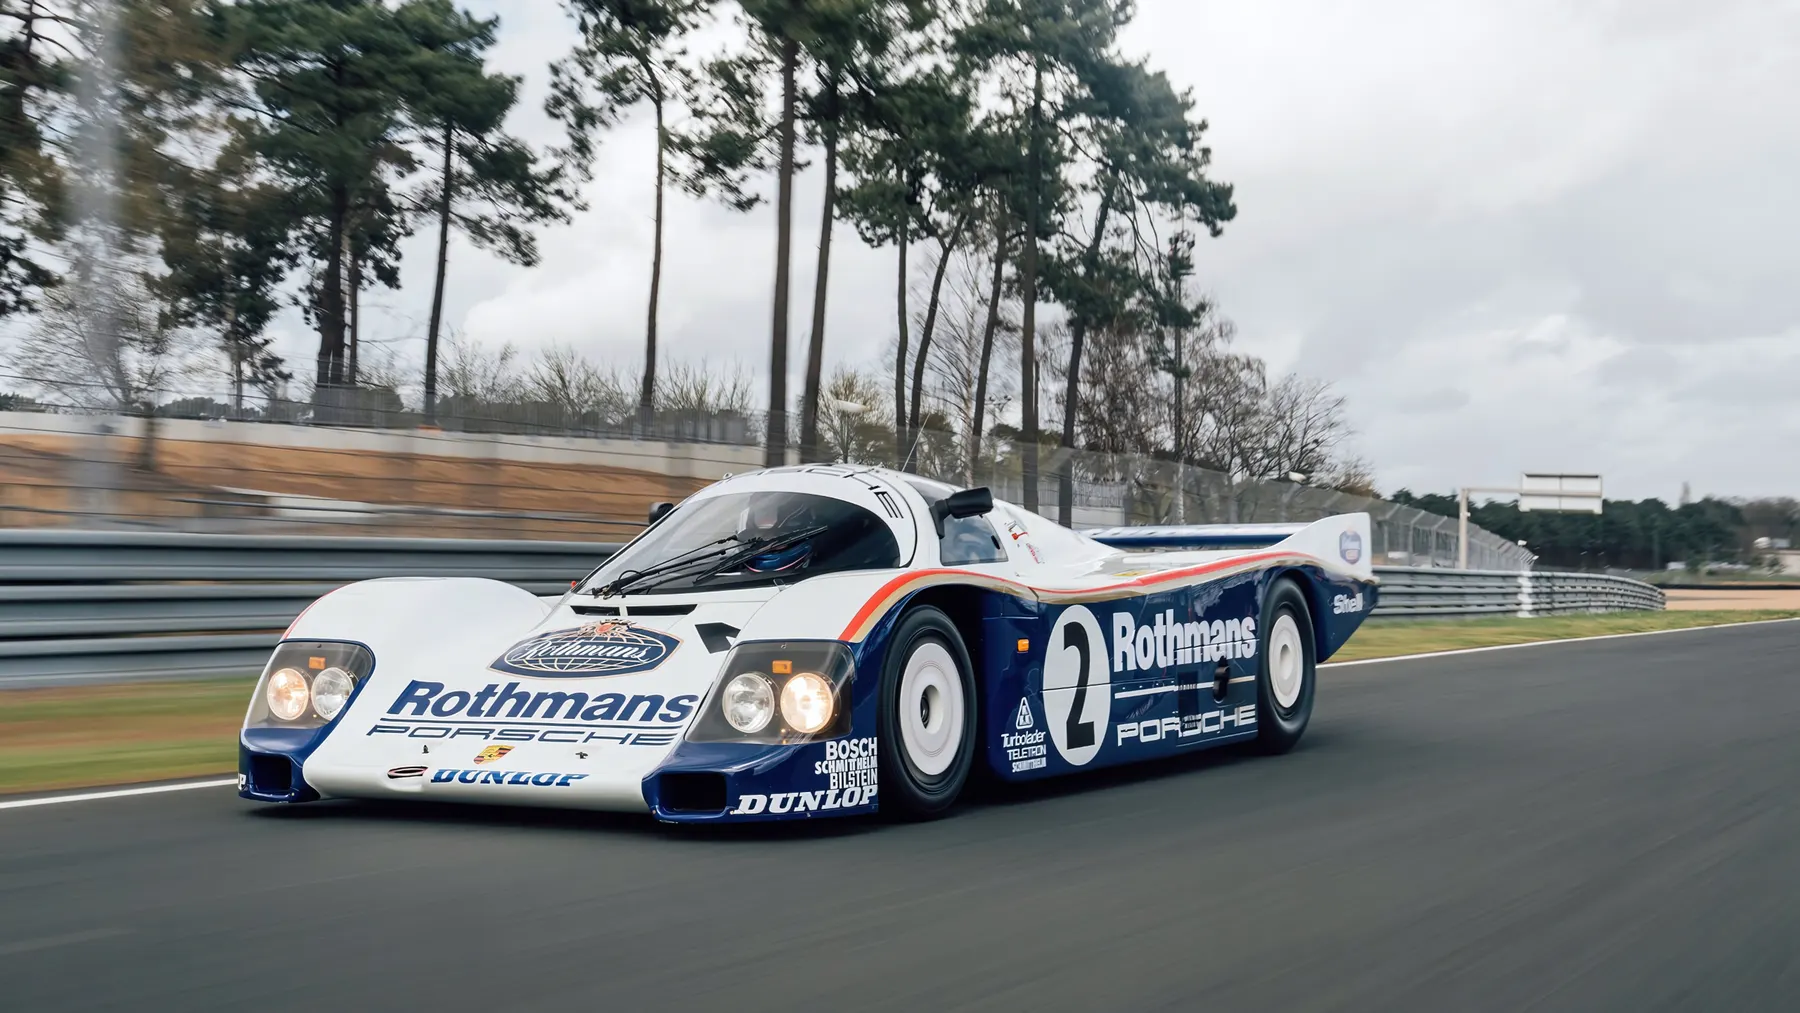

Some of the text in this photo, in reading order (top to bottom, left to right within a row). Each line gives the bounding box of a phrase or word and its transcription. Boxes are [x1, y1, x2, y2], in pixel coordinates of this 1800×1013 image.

[1333, 593, 1363, 614] Shell
[511, 640, 652, 663] Rothmans
[1113, 609, 1256, 672] Rothmans
[1064, 621, 1095, 750] 2
[386, 680, 700, 722] Rothmans
[366, 725, 679, 746] PORSCHE
[1117, 704, 1256, 746] PORSCHE
[826, 737, 877, 760] BOSCH
[1001, 729, 1046, 748] Turbolader
[815, 756, 878, 774] SCHMITTHELM
[431, 768, 589, 786] DUNLOP
[830, 769, 877, 789] BILSTEIN
[733, 785, 878, 815] DUNLOP
